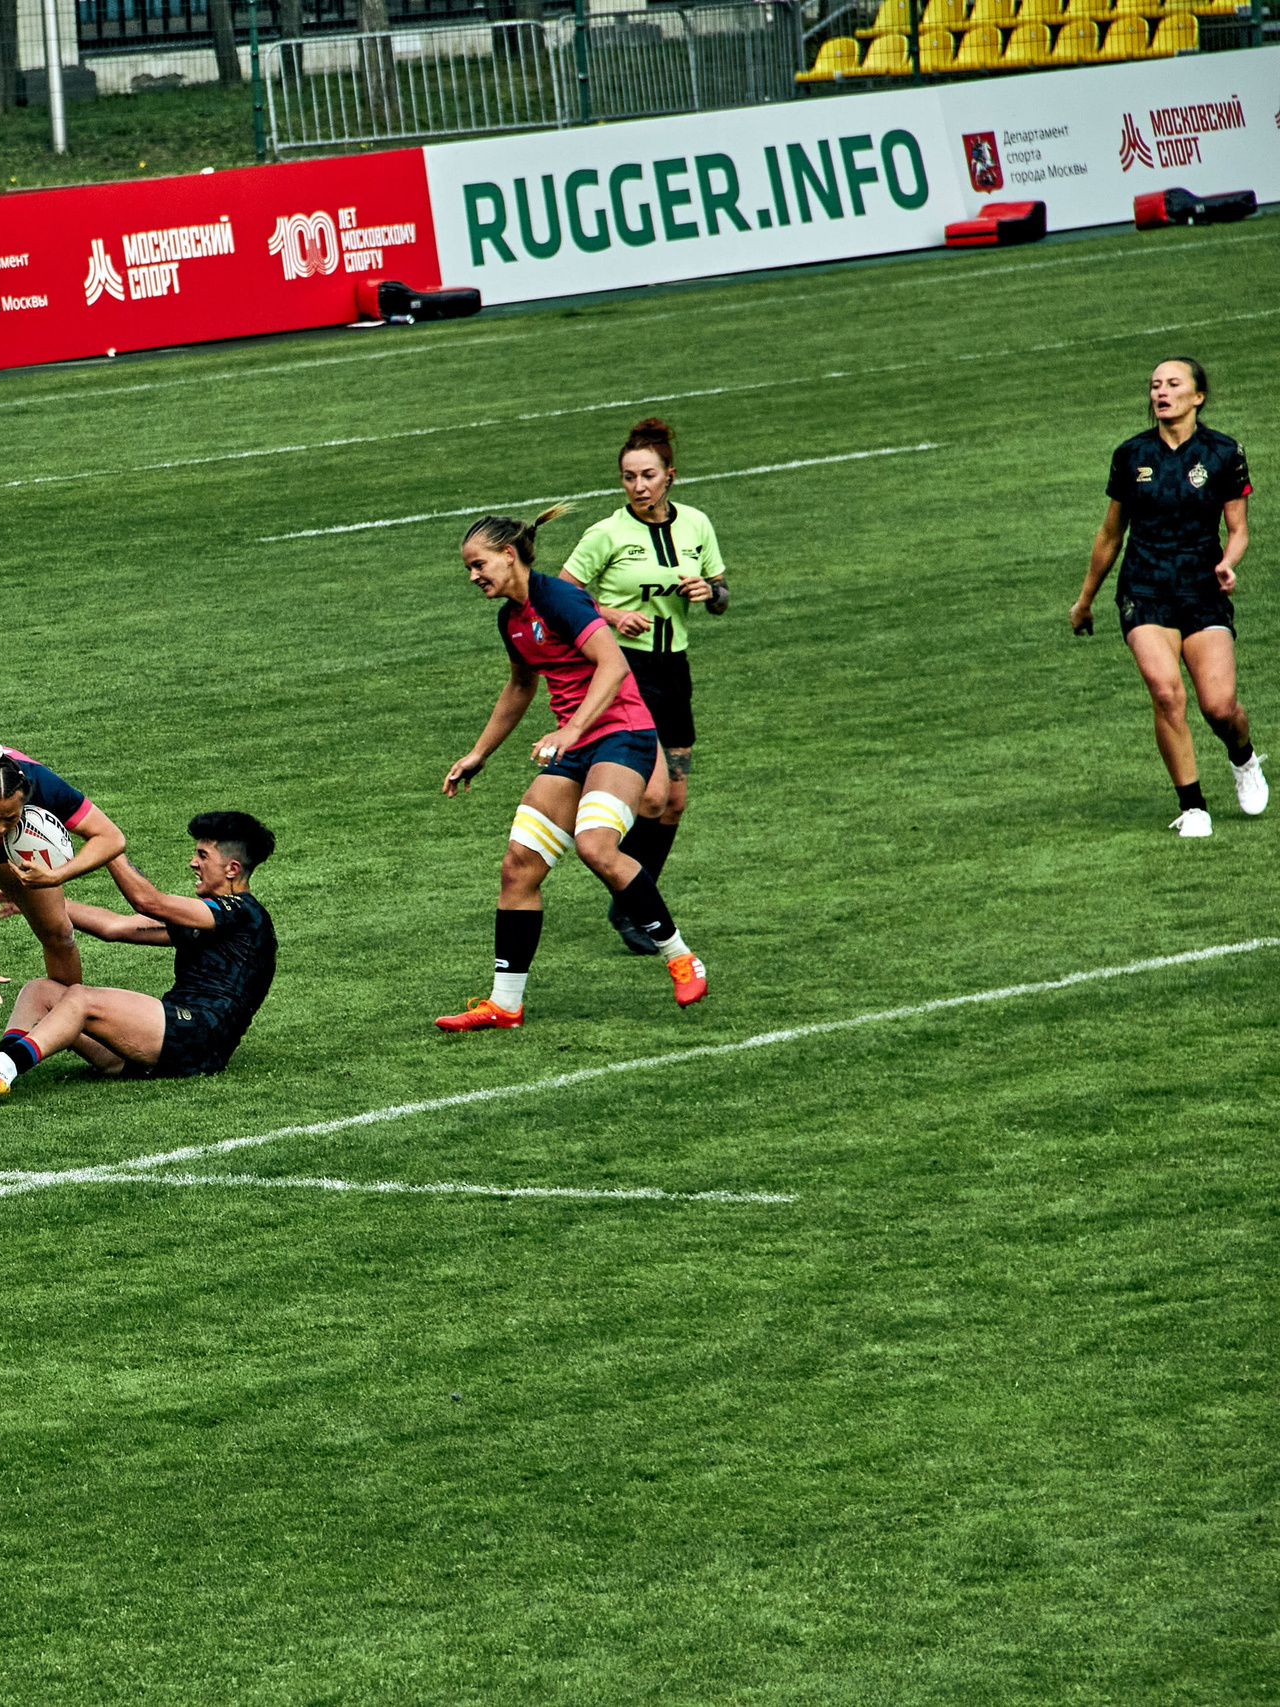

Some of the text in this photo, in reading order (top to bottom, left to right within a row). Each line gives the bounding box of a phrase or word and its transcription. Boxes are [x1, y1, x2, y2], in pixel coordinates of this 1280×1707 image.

[1150, 94, 1246, 137] МОСКОВСКИЙ
[1003, 126, 1069, 146] Департамент
[1006, 149, 1042, 167] спорта
[1156, 136, 1202, 168] СПОРТ
[1010, 162, 1088, 184] города Москвы
[462, 128, 930, 267] RUGGER.INFO
[338, 207, 357, 230] ЛЕТ
[122, 215, 235, 267] МОСКОВСКИЙ
[268, 210, 339, 280] 100
[340, 223, 416, 251] МОСКОВСКОМУ
[343, 249, 383, 273] СПОРТУ
[127, 263, 180, 300] СПОРТ
[1, 294, 49, 312] Москвы
